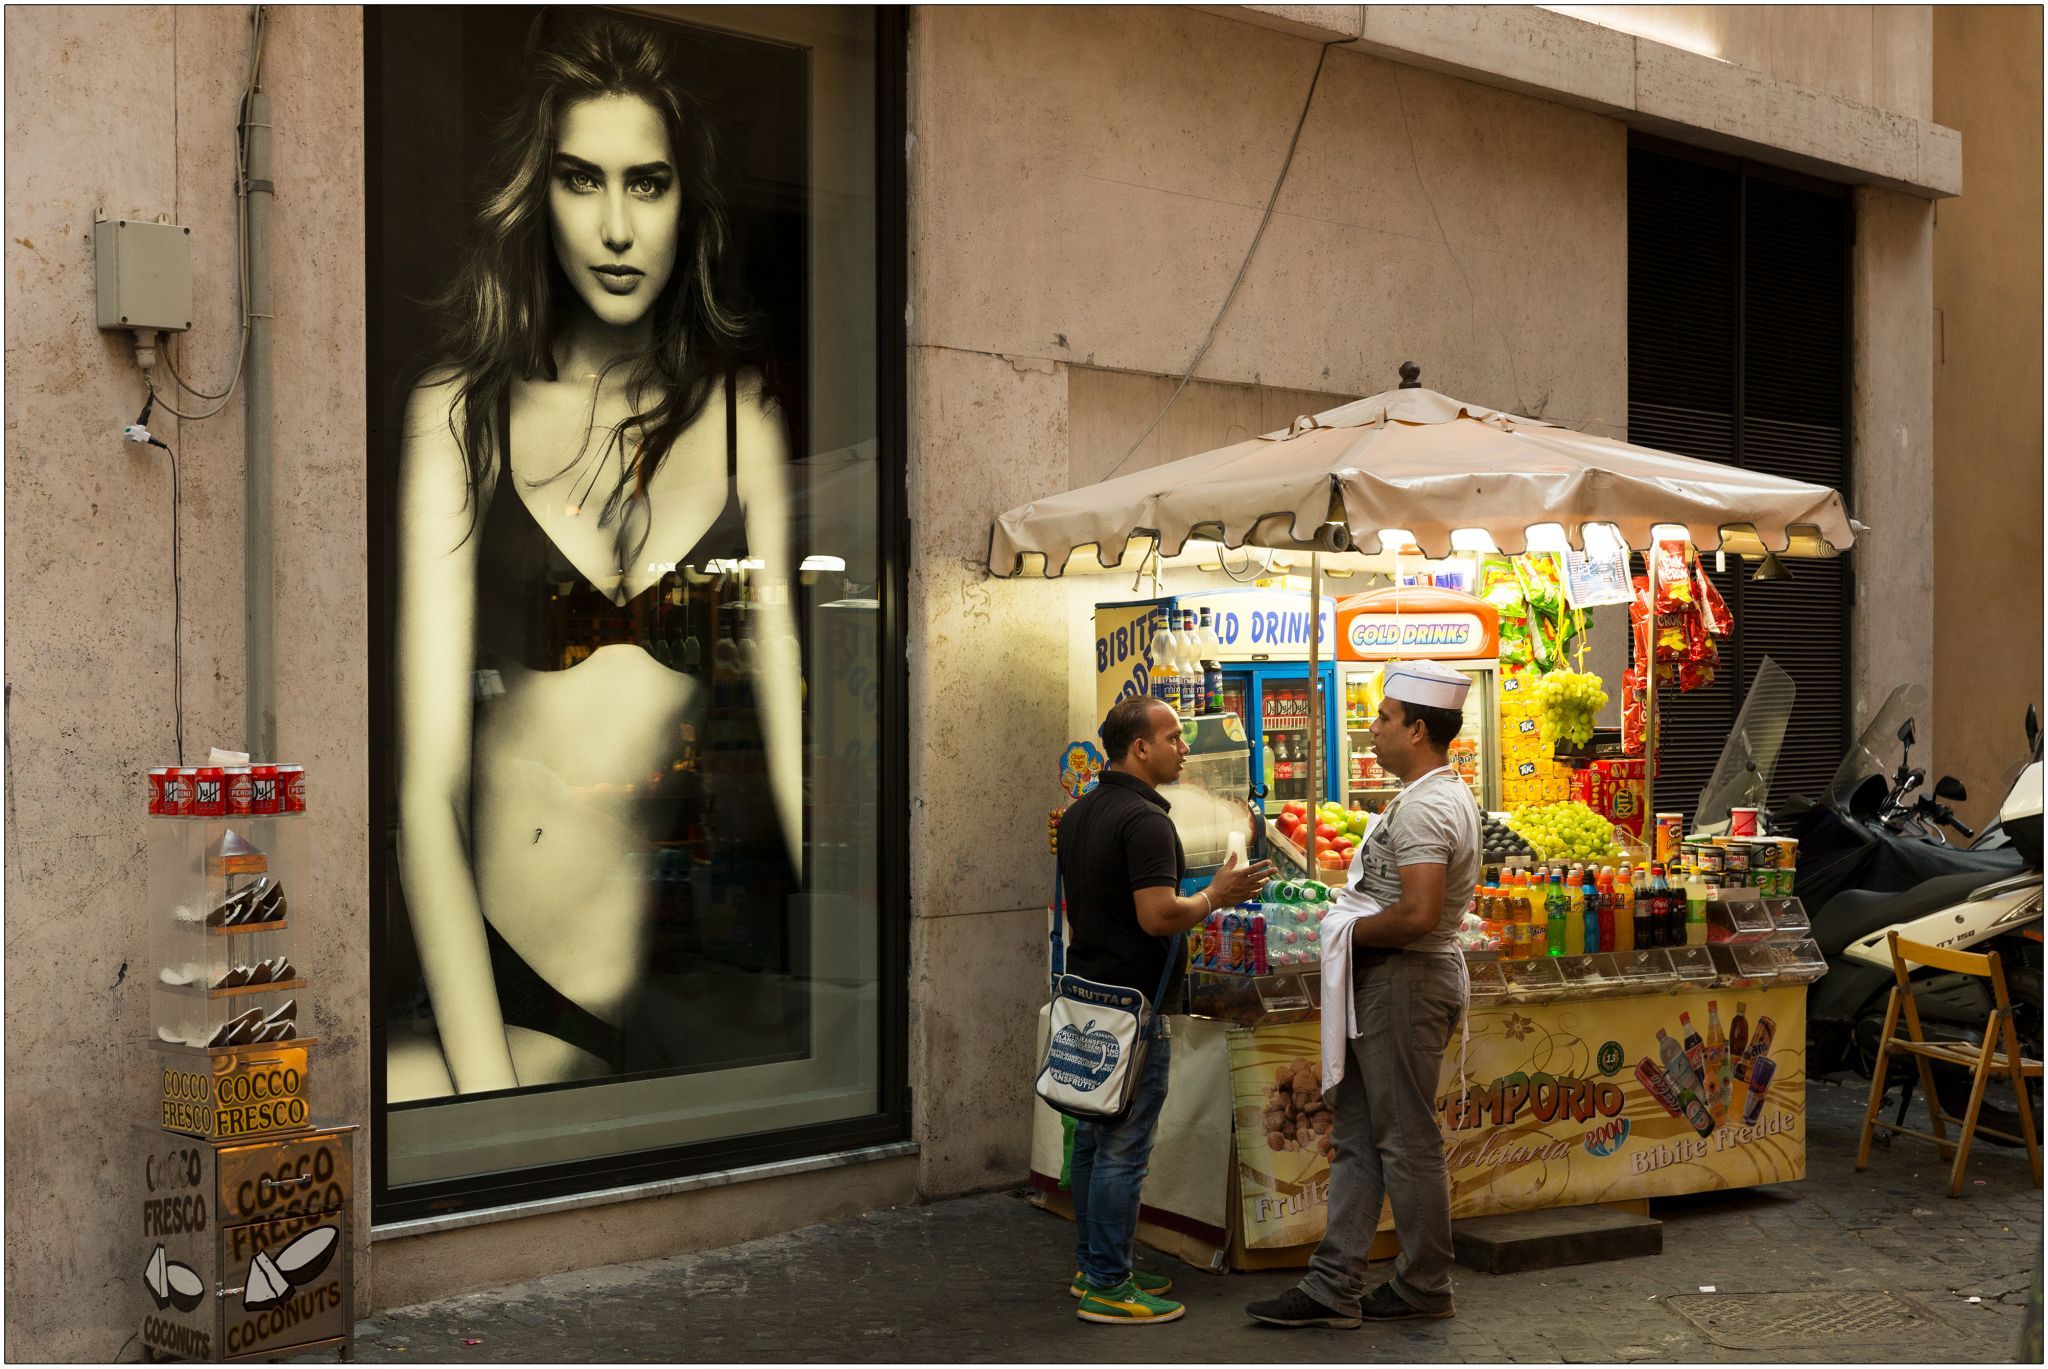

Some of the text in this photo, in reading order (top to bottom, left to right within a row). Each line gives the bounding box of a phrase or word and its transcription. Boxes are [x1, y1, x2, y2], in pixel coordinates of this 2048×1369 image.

[1352, 624, 1469, 645] COLD DRINKS
[1504, 680, 1518, 691] TUC
[1520, 720, 1534, 733] TUC
[1520, 763, 1534, 776] TUC
[196, 781, 220, 802] Duff
[252, 780, 276, 801] Duff
[1616, 790, 1631, 817] RITZ
[1956, 930, 1975, 940] 150
[1072, 985, 1119, 1005] FRUTTA
[1605, 1053, 1617, 1063] 13
[163, 1070, 209, 1101] COCCO
[217, 1069, 300, 1105] COCCO
[162, 1101, 212, 1132] FRESCO
[216, 1099, 305, 1136] FRESCO
[1584, 1117, 1625, 1150] 2000
[1630, 1140, 1708, 1176] Bibite
[1715, 1111, 1795, 1154] Fredde
[1446, 1132, 1571, 1168] Dolciaria
[237, 1146, 334, 1218] COCCO
[144, 1194, 206, 1237] FRESCO
[232, 1182, 345, 1262] FRESCO
[227, 1281, 341, 1350] COCONUTS
[143, 1315, 210, 1360] COCONUTS
